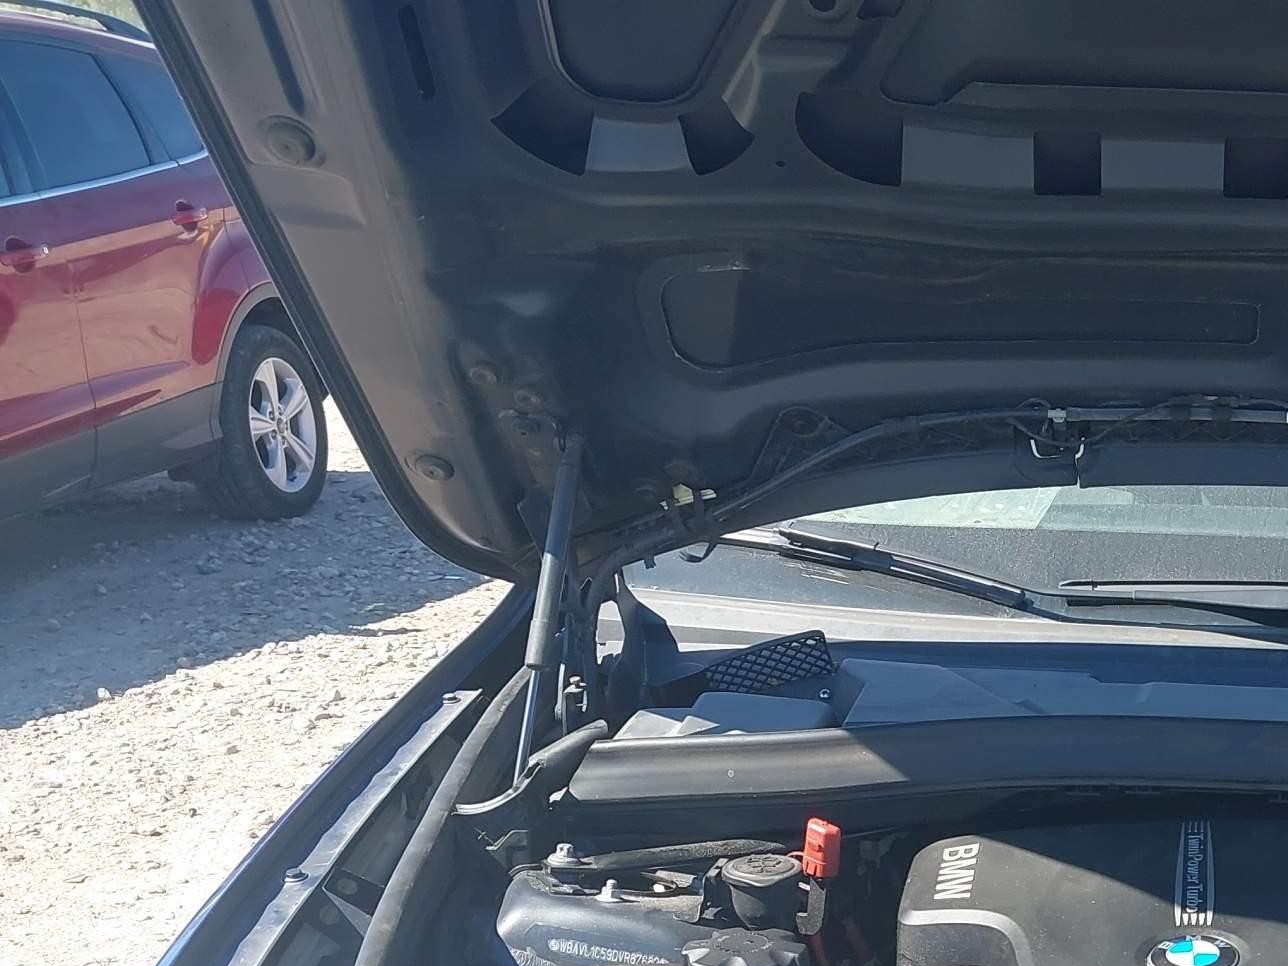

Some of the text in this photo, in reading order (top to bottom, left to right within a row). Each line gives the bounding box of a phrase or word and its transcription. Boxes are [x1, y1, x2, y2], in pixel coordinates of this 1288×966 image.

[934, 843, 980, 900] BMW
[1186, 832, 1204, 913] TwinPower Turbo
[1158, 935, 1230, 950] BMW
